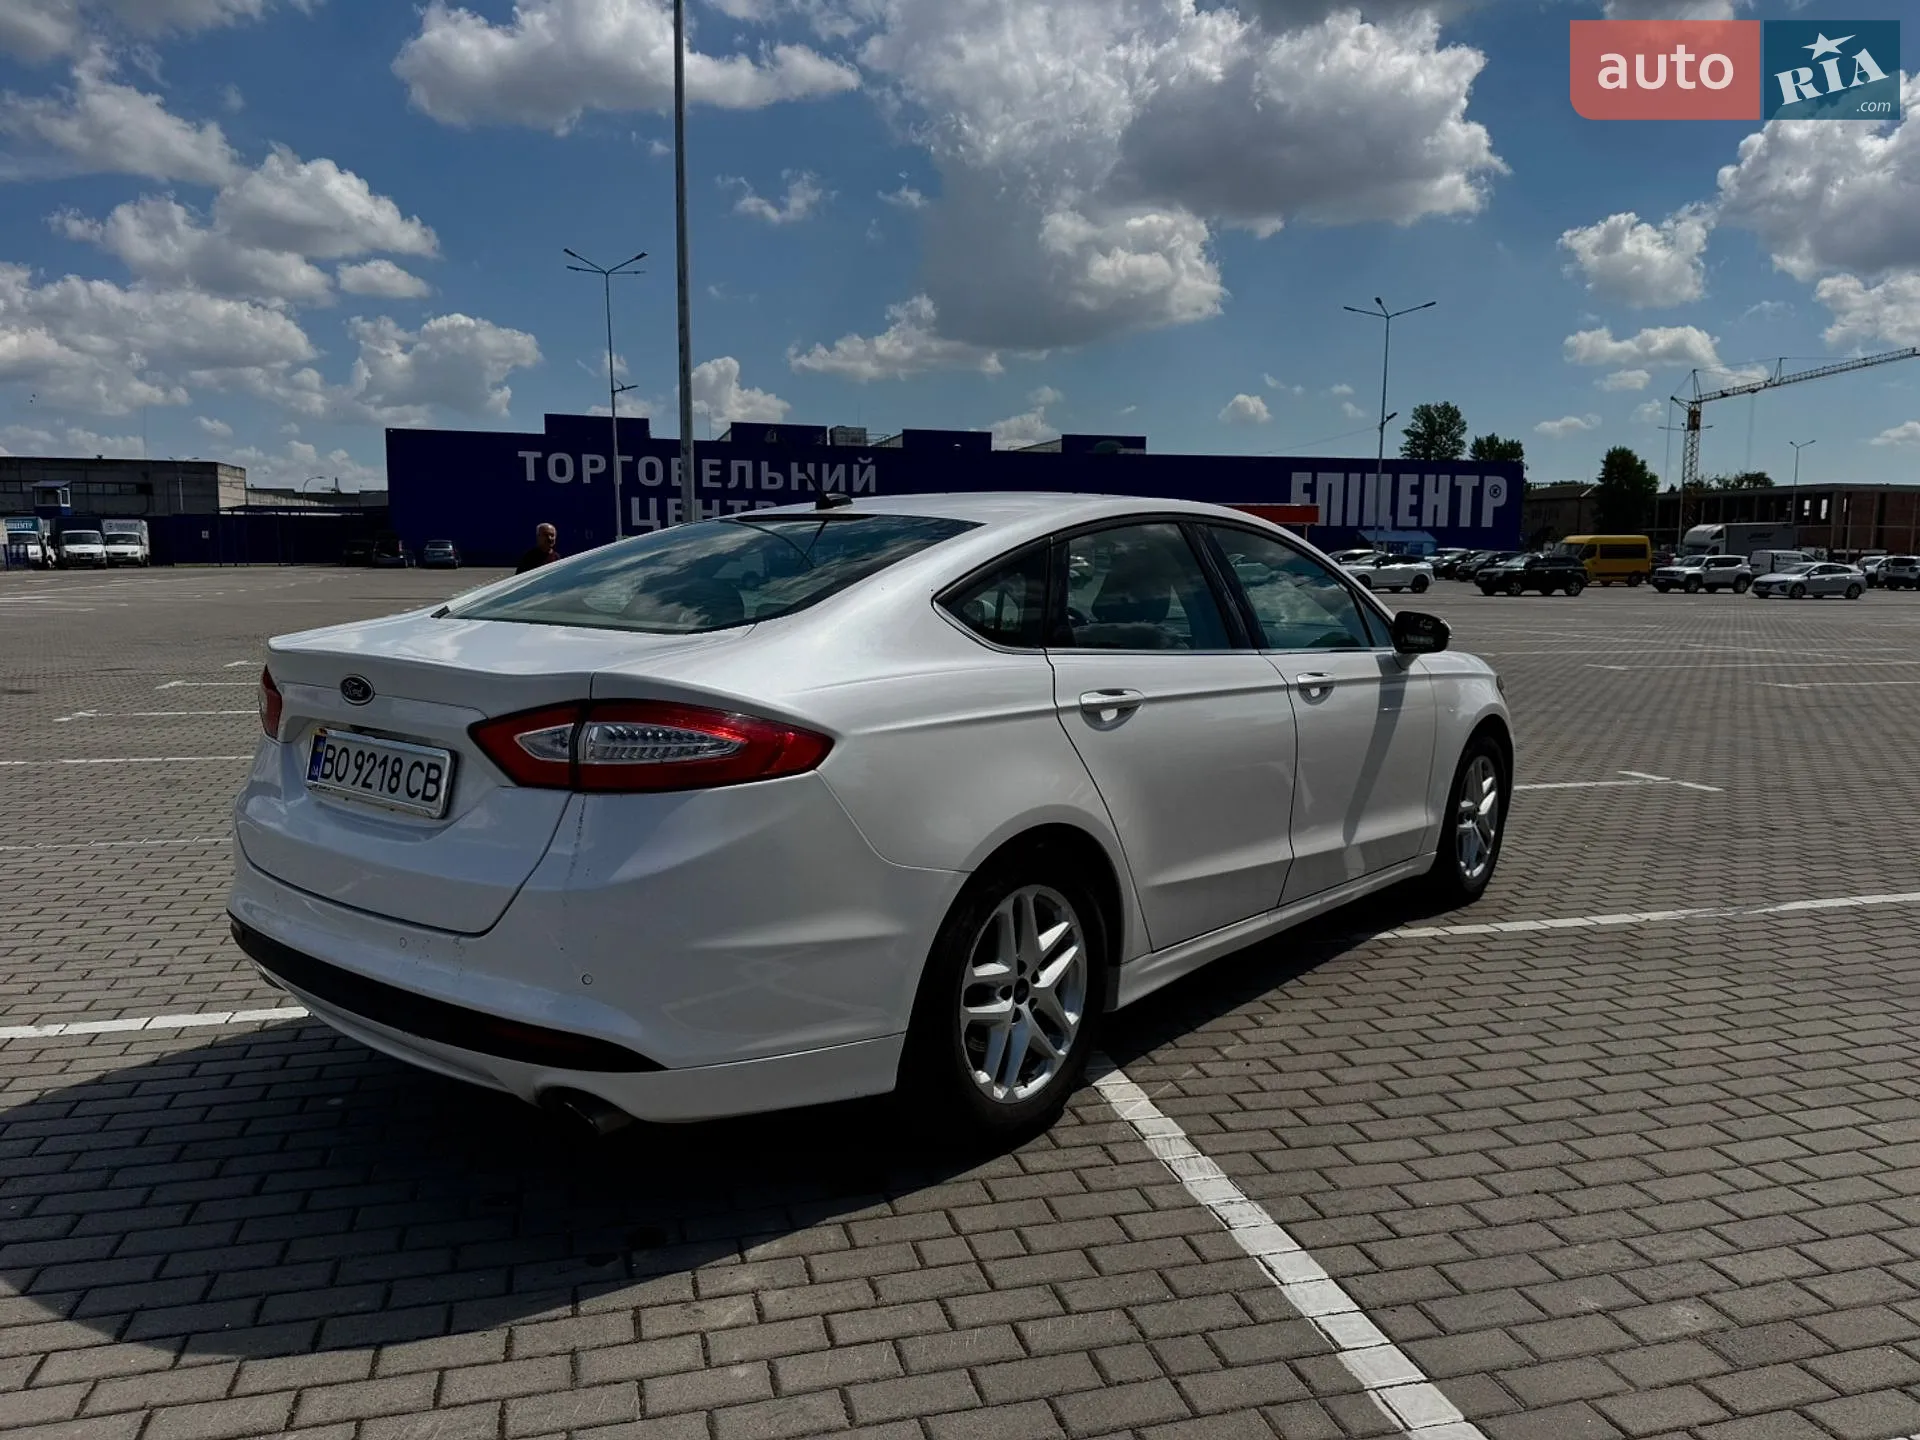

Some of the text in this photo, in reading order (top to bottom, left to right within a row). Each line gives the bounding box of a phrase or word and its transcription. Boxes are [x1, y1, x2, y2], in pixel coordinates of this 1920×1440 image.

[631, 496, 778, 529] ЦЕНТ
[1290, 472, 1508, 532] ЕПІЦЕНТР
[320, 744, 442, 802] BO 9218 CB
